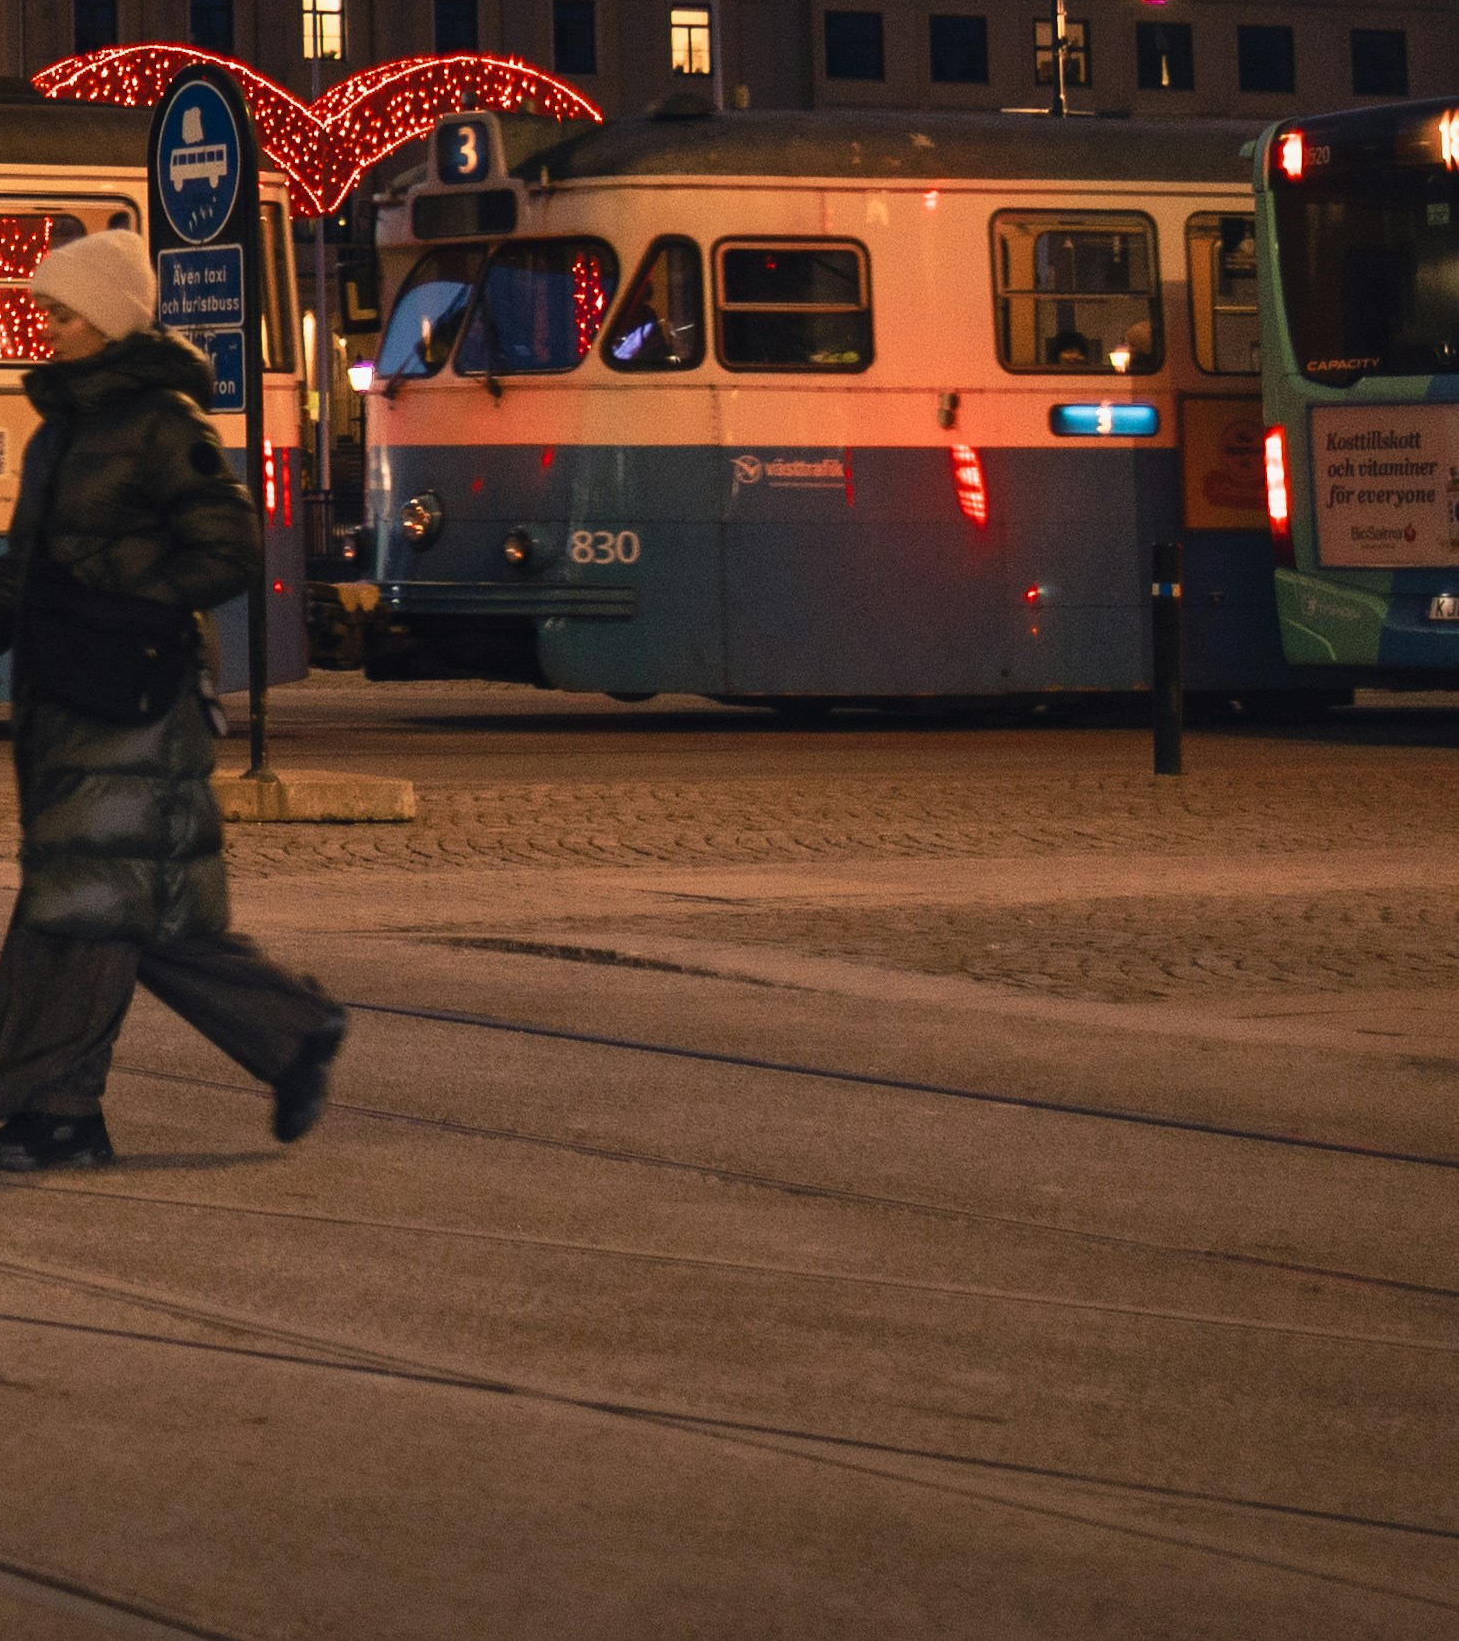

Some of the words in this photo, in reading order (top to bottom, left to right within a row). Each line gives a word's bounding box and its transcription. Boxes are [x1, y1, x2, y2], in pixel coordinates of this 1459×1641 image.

[457, 125, 478, 174] 3
[172, 263, 201, 286] Även
[204, 266, 227, 283] taxi
[161, 298, 179, 315] och
[182, 295, 240, 314] turistbuss
[1306, 358, 1380, 372] CAPACITY
[213, 379, 236, 395] ron
[1095, 406, 1112, 434] 3
[1326, 430, 1421, 451] Kosttillskott
[1327, 458, 1355, 478] och
[1358, 458, 1438, 477] vitaminer
[1326, 485, 1355, 509] för
[1357, 488, 1436, 508] everyone
[570, 530, 641, 565] 830
